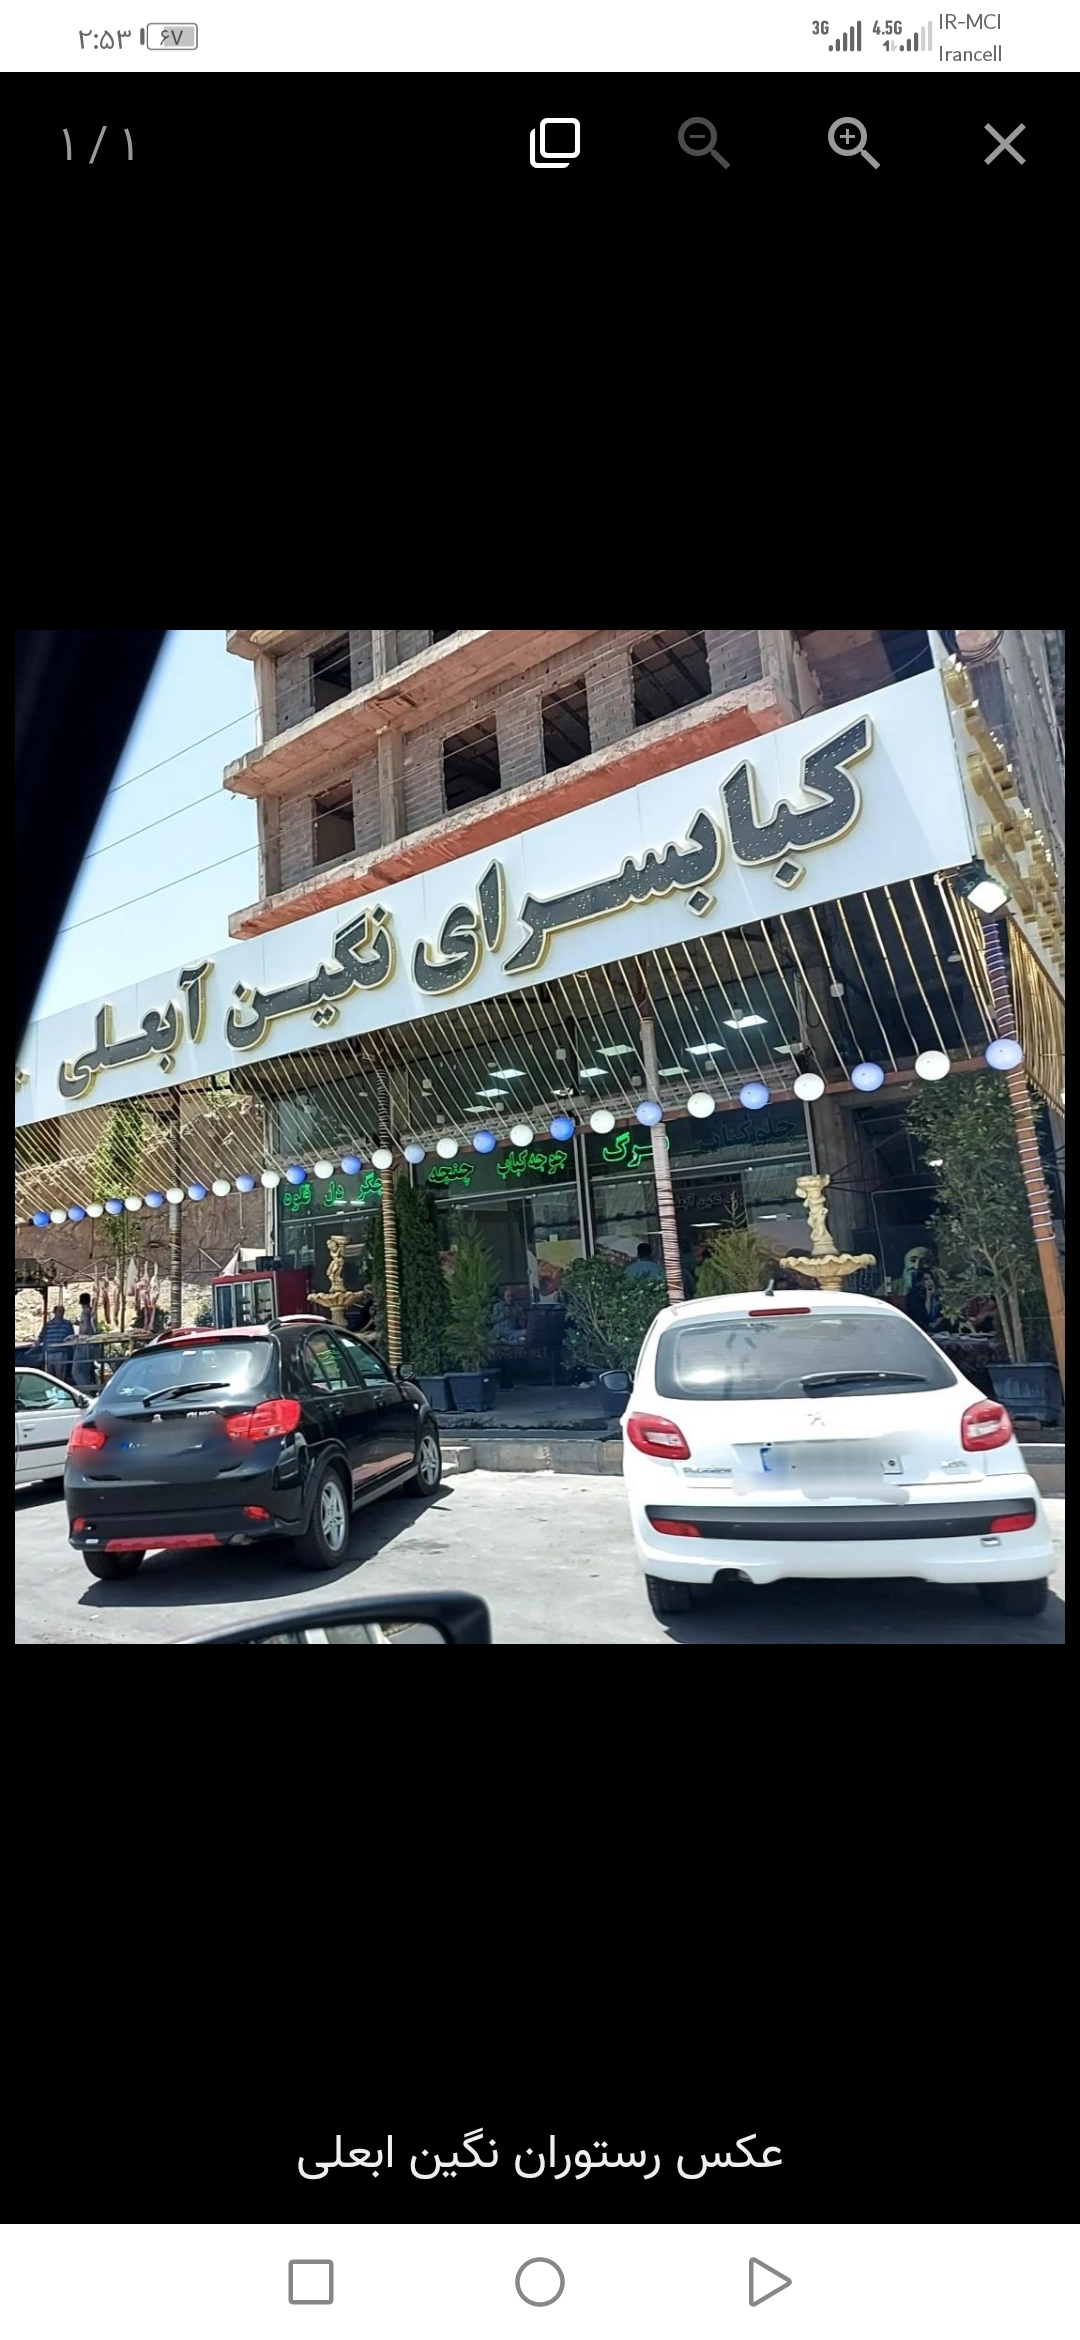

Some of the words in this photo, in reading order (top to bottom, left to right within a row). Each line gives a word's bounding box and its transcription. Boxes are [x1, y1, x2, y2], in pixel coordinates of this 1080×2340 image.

[411, 713, 875, 996] کبابسرای
[224, 903, 397, 1052] نگین
[57, 959, 216, 1100] آبعلی
[428, 1162, 475, 1187] چنجه
[496, 1149, 528, 1180] کباب
[283, 1182, 313, 1213] قلوه
[323, 1181, 345, 1207] دل
